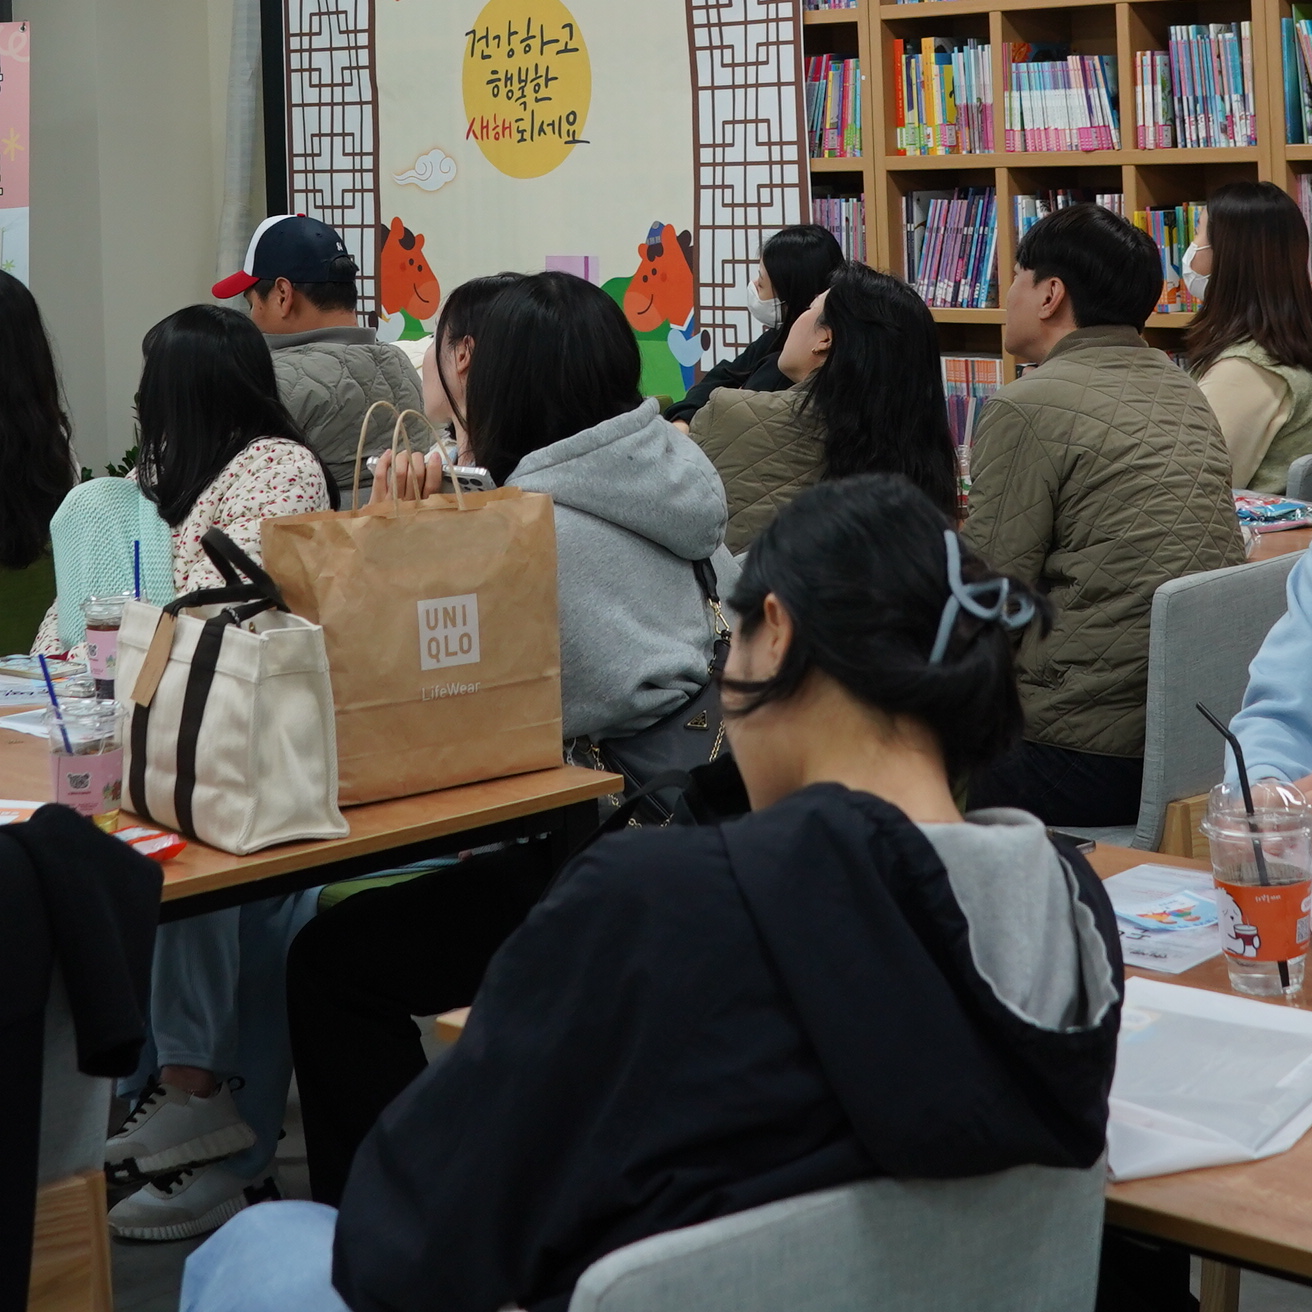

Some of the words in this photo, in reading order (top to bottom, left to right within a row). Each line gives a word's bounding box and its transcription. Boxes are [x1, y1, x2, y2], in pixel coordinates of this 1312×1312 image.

[465, 17, 580, 61] 건강하고
[486, 63, 559, 112] 행복한
[425, 603, 469, 631] UNI
[426, 634, 474, 663] QLO
[422, 680, 481, 702] LifeWear
